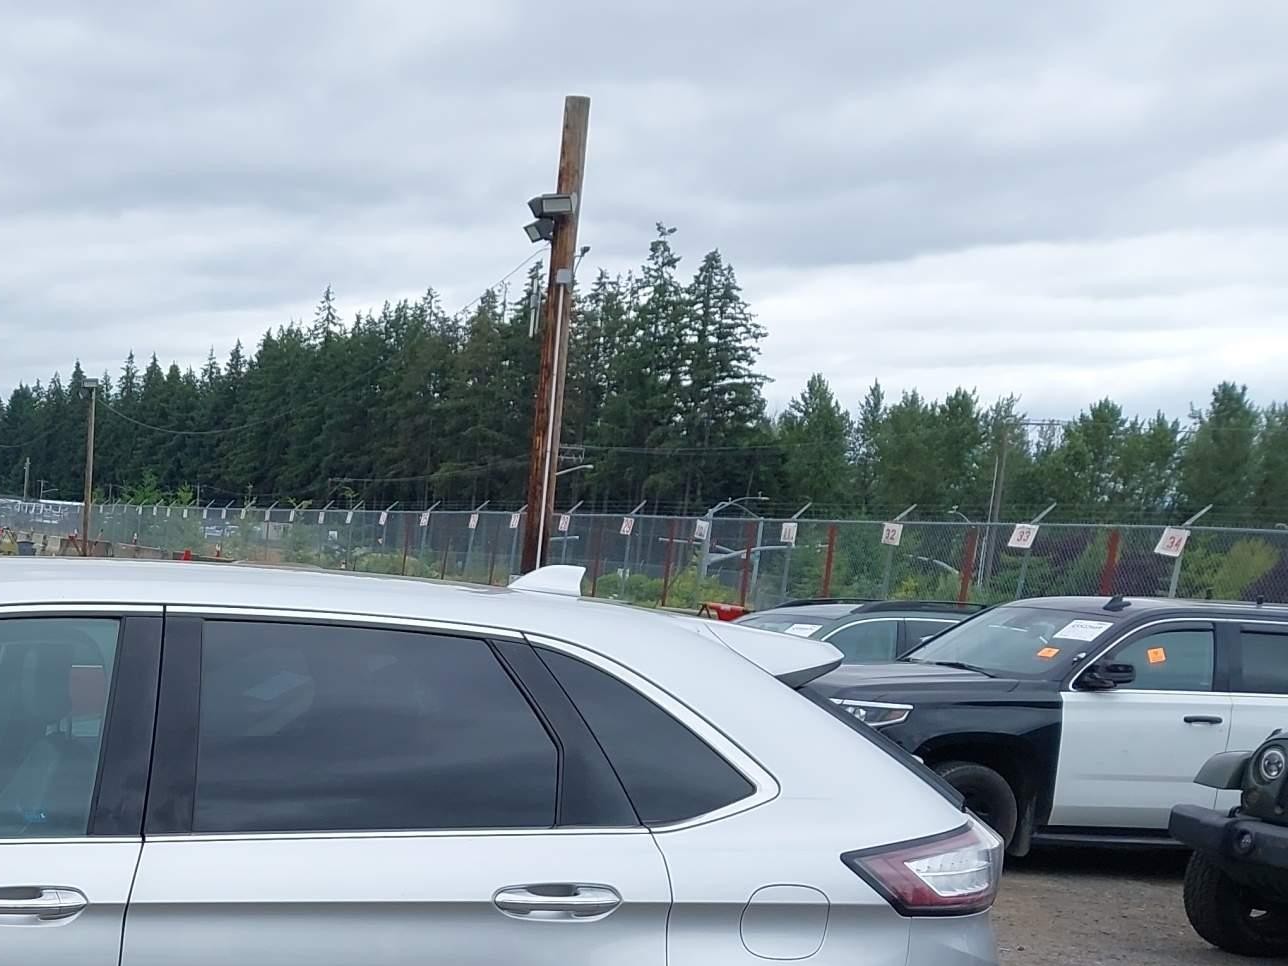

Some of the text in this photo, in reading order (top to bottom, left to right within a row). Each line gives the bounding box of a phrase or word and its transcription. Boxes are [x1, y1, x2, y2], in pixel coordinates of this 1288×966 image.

[885, 528, 897, 541] 32
[1016, 530, 1031, 543] 33
[1165, 536, 1183, 551] 34
